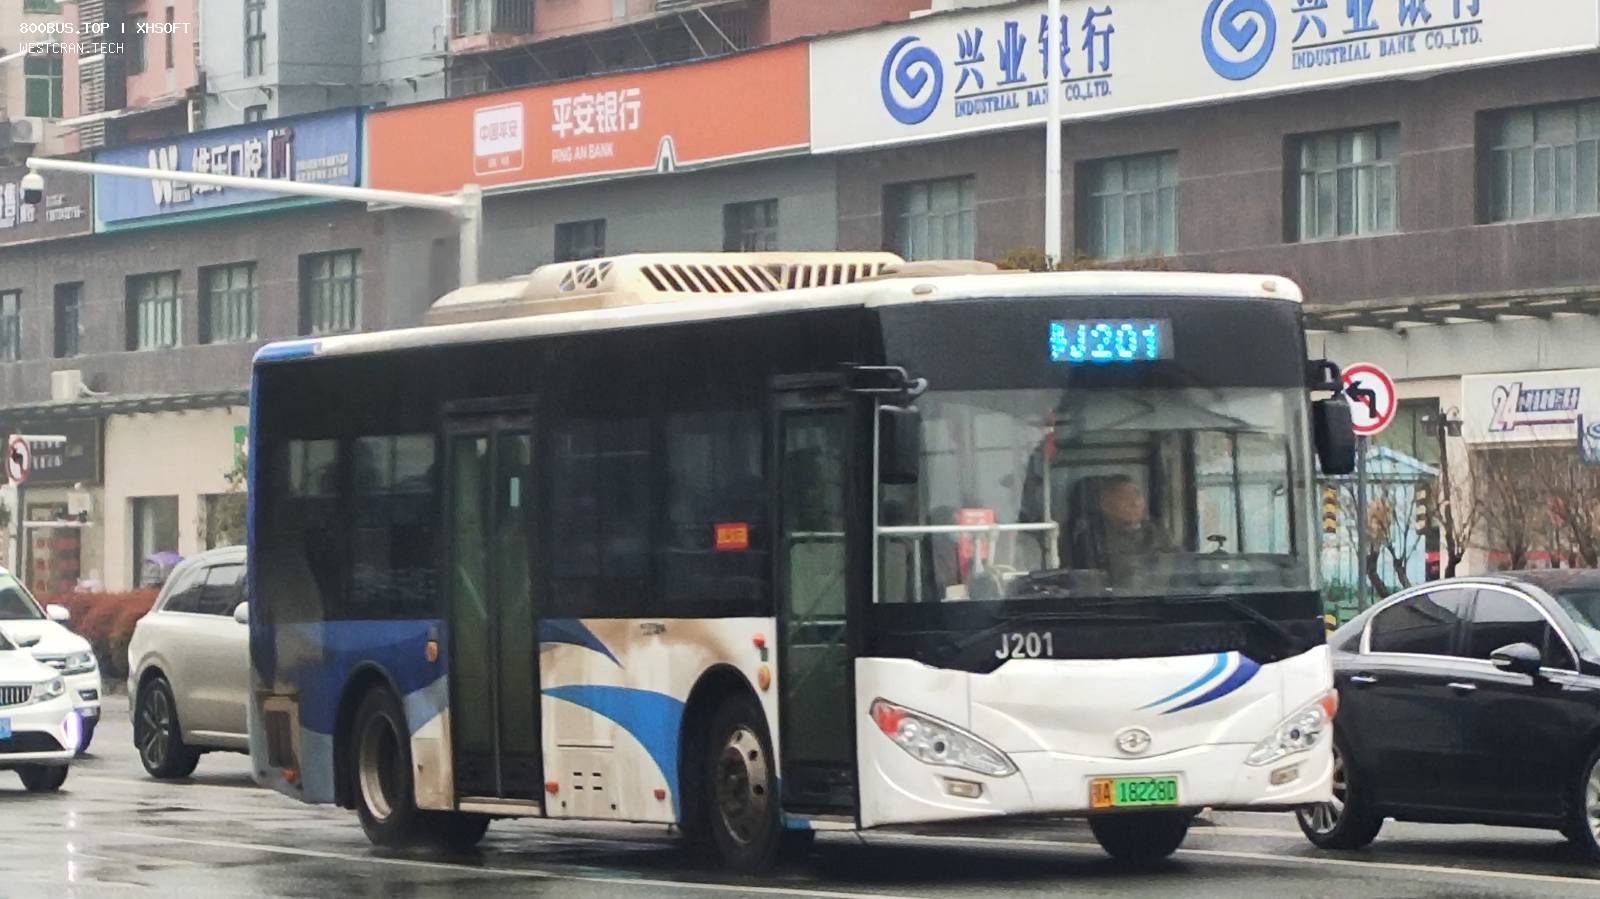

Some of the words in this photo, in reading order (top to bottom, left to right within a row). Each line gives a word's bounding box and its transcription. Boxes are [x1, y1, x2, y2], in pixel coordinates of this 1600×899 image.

[954, 6, 1114, 93] 兴业银行
[1292, 42, 1371, 70] INDUSTRIAL
[1379, 33, 1416, 57] BANK
[551, 87, 641, 139] 平安银行
[954, 93, 1019, 117] INDUSTRIAL
[1027, 90, 1049, 108] BAN
[552, 146, 572, 163] PING
[574, 144, 587, 161] AN
[589, 142, 614, 159] BANK
[995, 632, 1054, 659] J201
